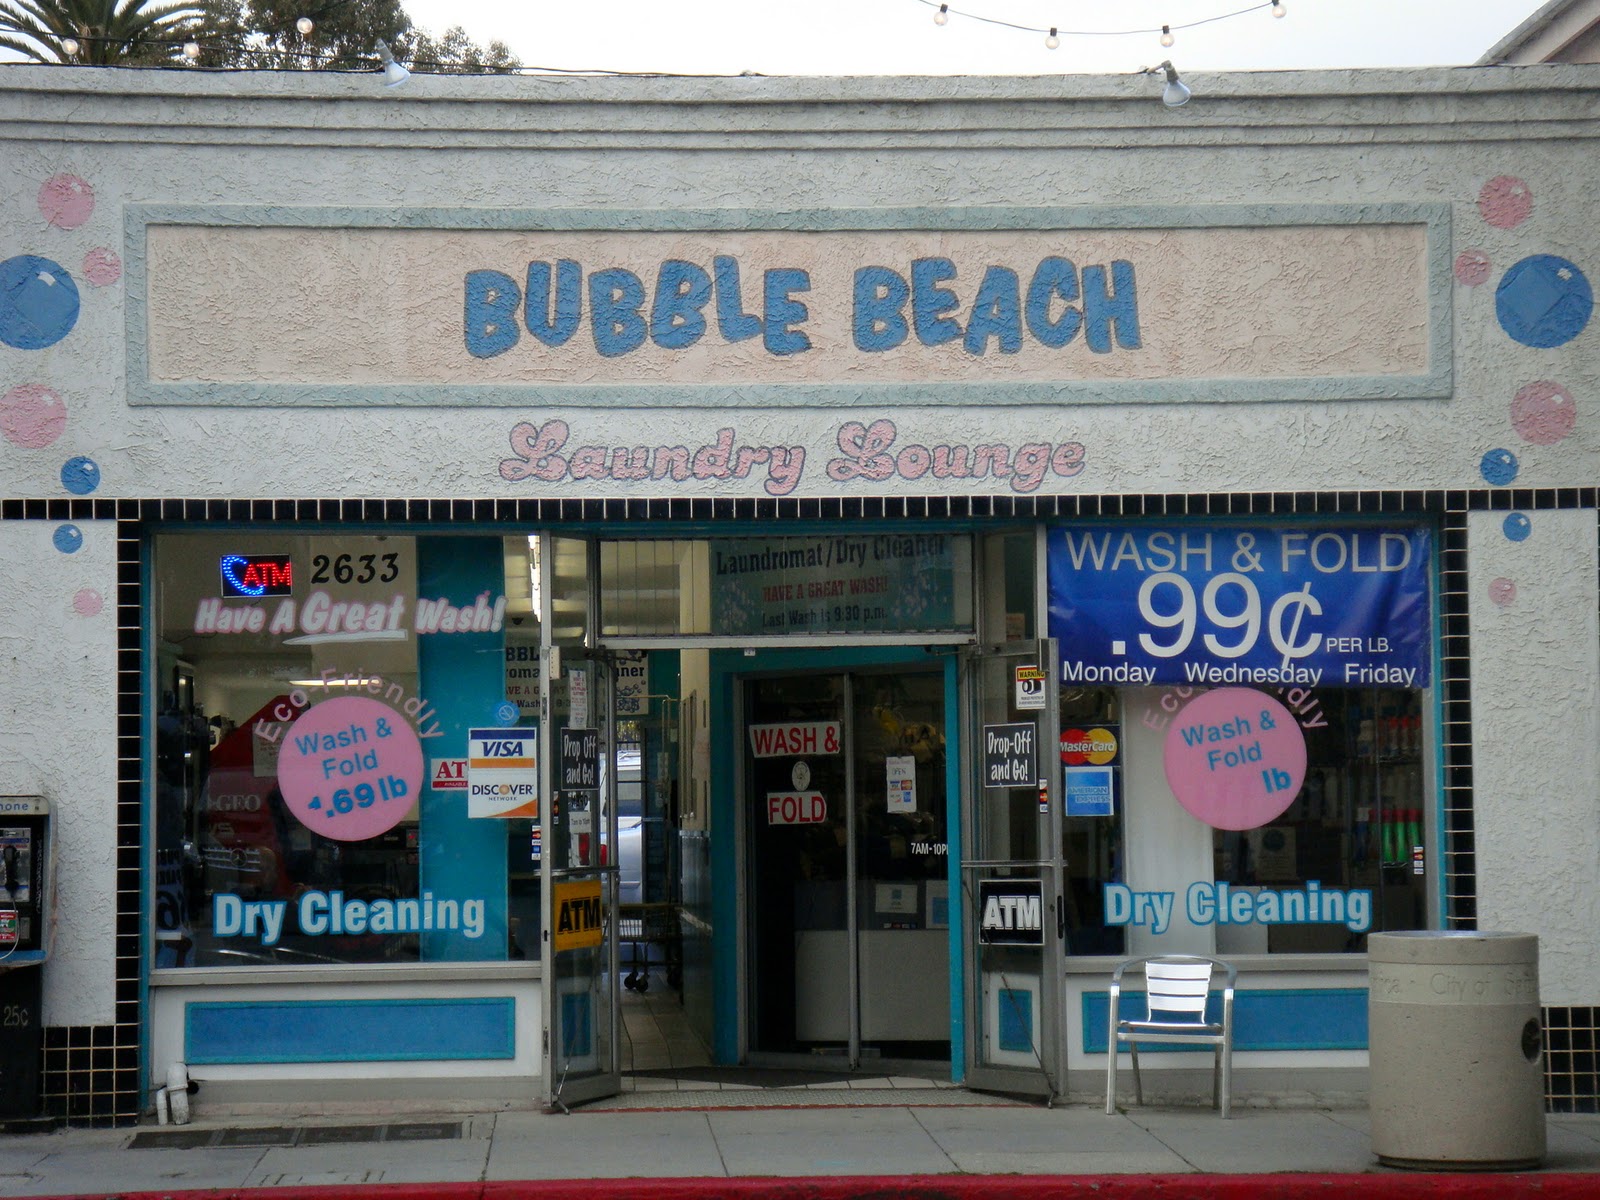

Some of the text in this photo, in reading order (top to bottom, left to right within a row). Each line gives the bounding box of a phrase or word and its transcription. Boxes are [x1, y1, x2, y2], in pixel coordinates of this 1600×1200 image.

[463, 255, 1143, 358] BUBBLE BEACH
[499, 418, 1085, 496] Laundry Lounge
[1065, 531, 1412, 573] WASH & FOLD
[243, 562, 292, 587] ATM
[311, 552, 399, 584] 2633
[761, 583, 793, 602] HAVE
[796, 584, 804, 600] A
[807, 580, 846, 599] GREAT
[193, 591, 507, 635] Have A Great Wash!
[762, 611, 785, 628] Last
[788, 607, 816, 625] Wash
[820, 607, 831, 623] is
[506, 646, 540, 661] BBL
[1326, 637, 1393, 653] PER LB.
[1063, 661, 1416, 686] Monday Wednesday Friday
[294, 724, 367, 756] Wash
[376, 717, 393, 739] &
[753, 725, 840, 755] WASH &
[1181, 709, 1277, 747] Wash &
[481, 741, 524, 757] VISA
[1060, 741, 1116, 752] MasterCard
[1207, 741, 1263, 771] Fold
[322, 748, 379, 779] Fold
[436, 761, 467, 778] AT
[566, 764, 581, 784] and
[991, 759, 1010, 781] and
[472, 784, 534, 796] DISCOVER
[1067, 786, 1107, 794] AMERICAN
[769, 796, 826, 823] FOLD
[213, 892, 287, 946] Dry
[299, 890, 486, 938] Cleaning
[557, 895, 600, 935] ATM
[982, 895, 1042, 931] ATM
[1104, 880, 1373, 934] Dry Cleaning
